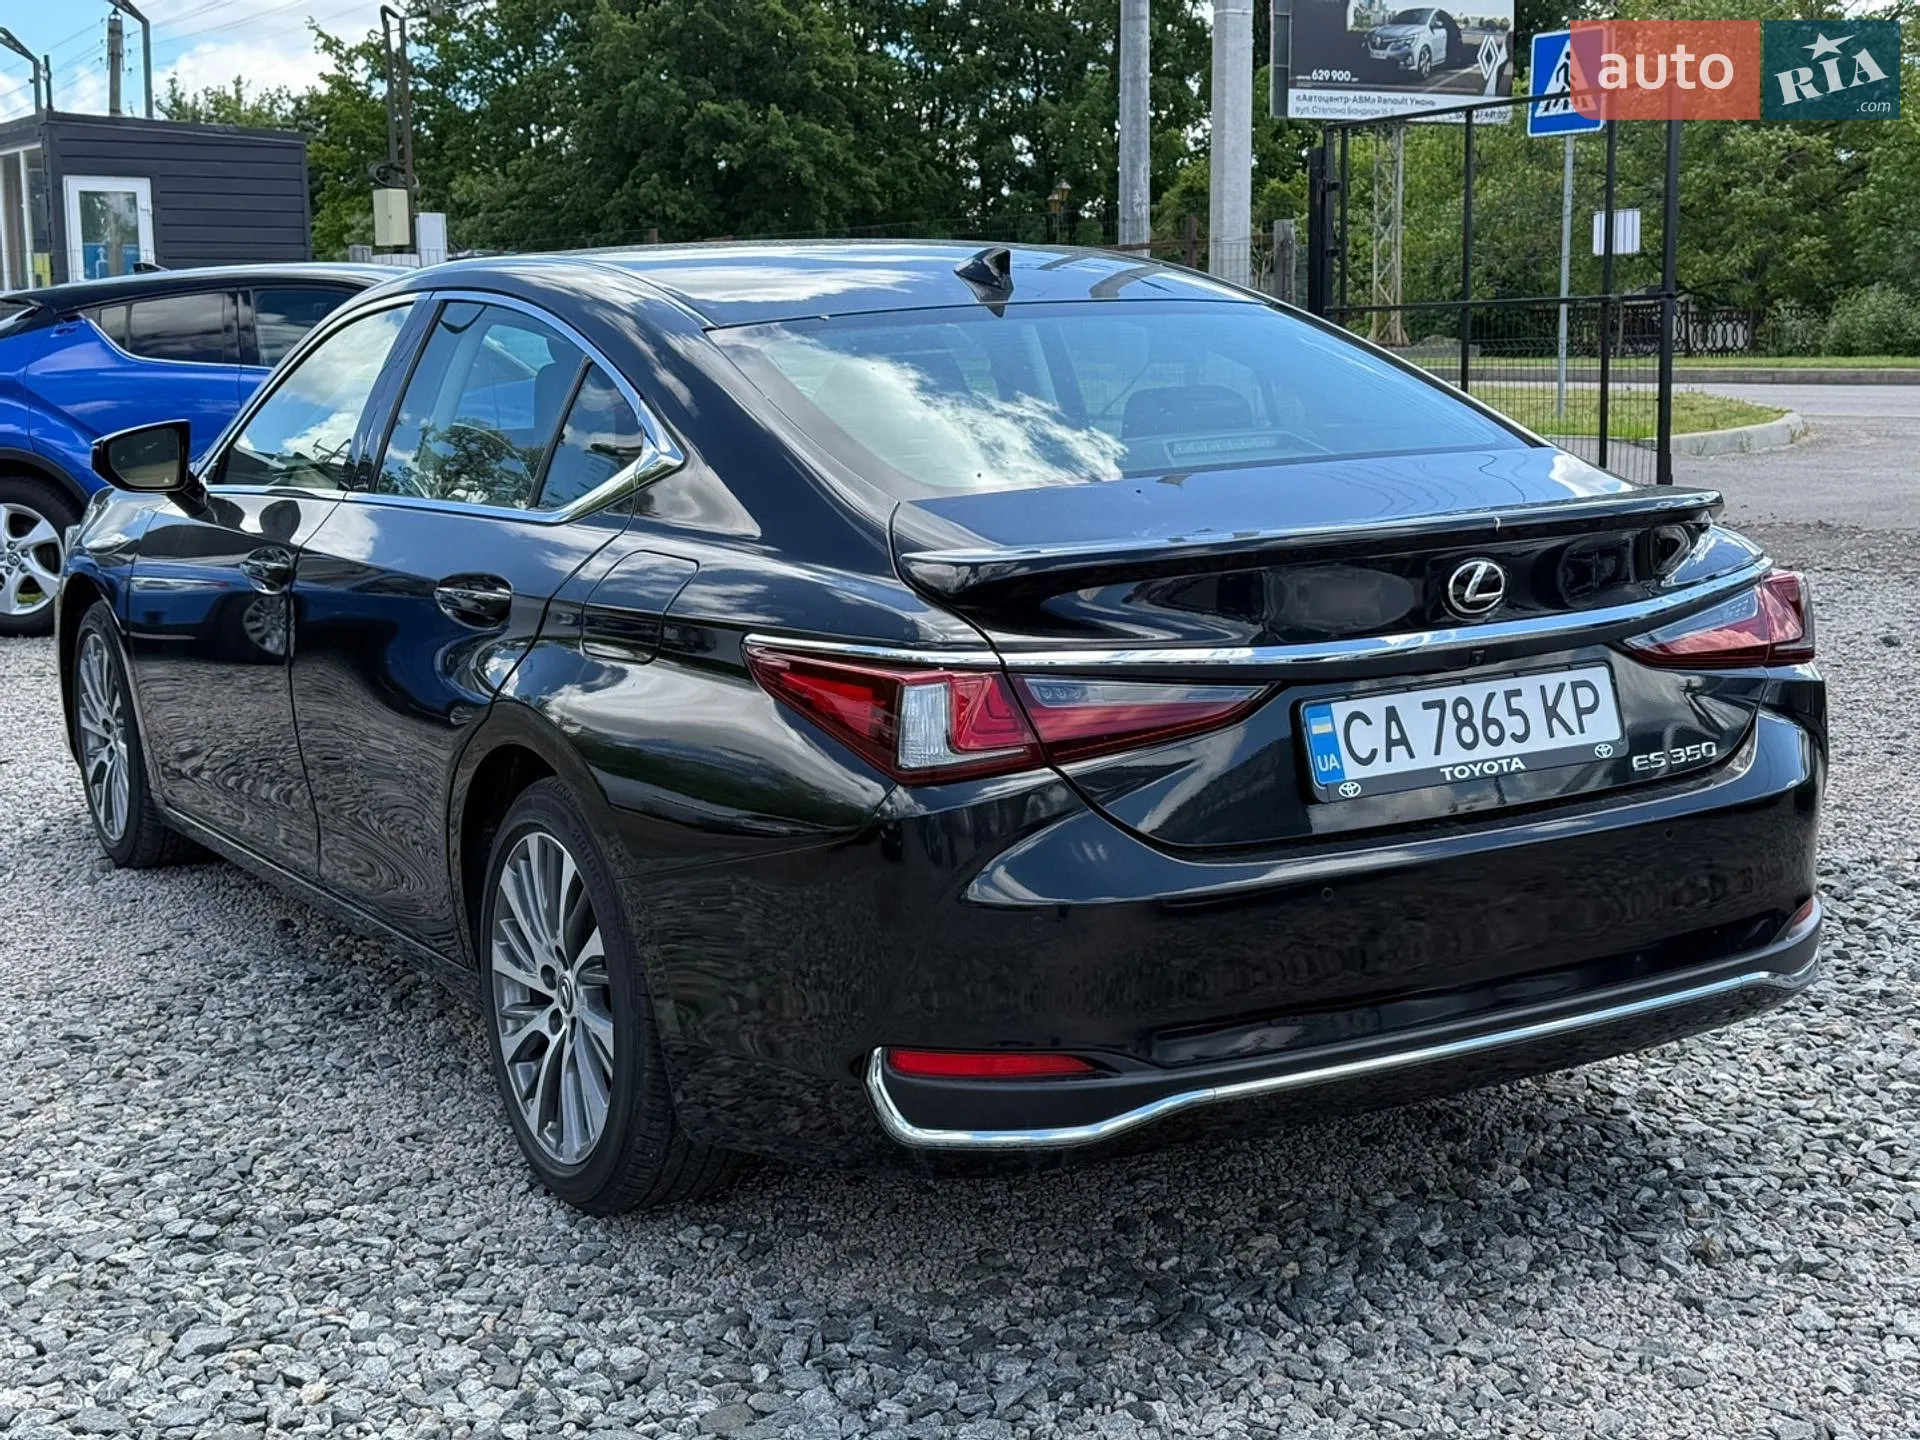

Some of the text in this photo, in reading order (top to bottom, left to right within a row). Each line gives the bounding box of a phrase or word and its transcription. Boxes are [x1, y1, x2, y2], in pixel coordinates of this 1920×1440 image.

[1312, 69, 1330, 80] 629
[1331, 70, 1351, 81] 900
[1343, 679, 1600, 767] CA 7865 KP
[1318, 754, 1341, 772] UA
[1632, 741, 1718, 772] ES 350
[1440, 757, 1526, 782] TOYOTA
